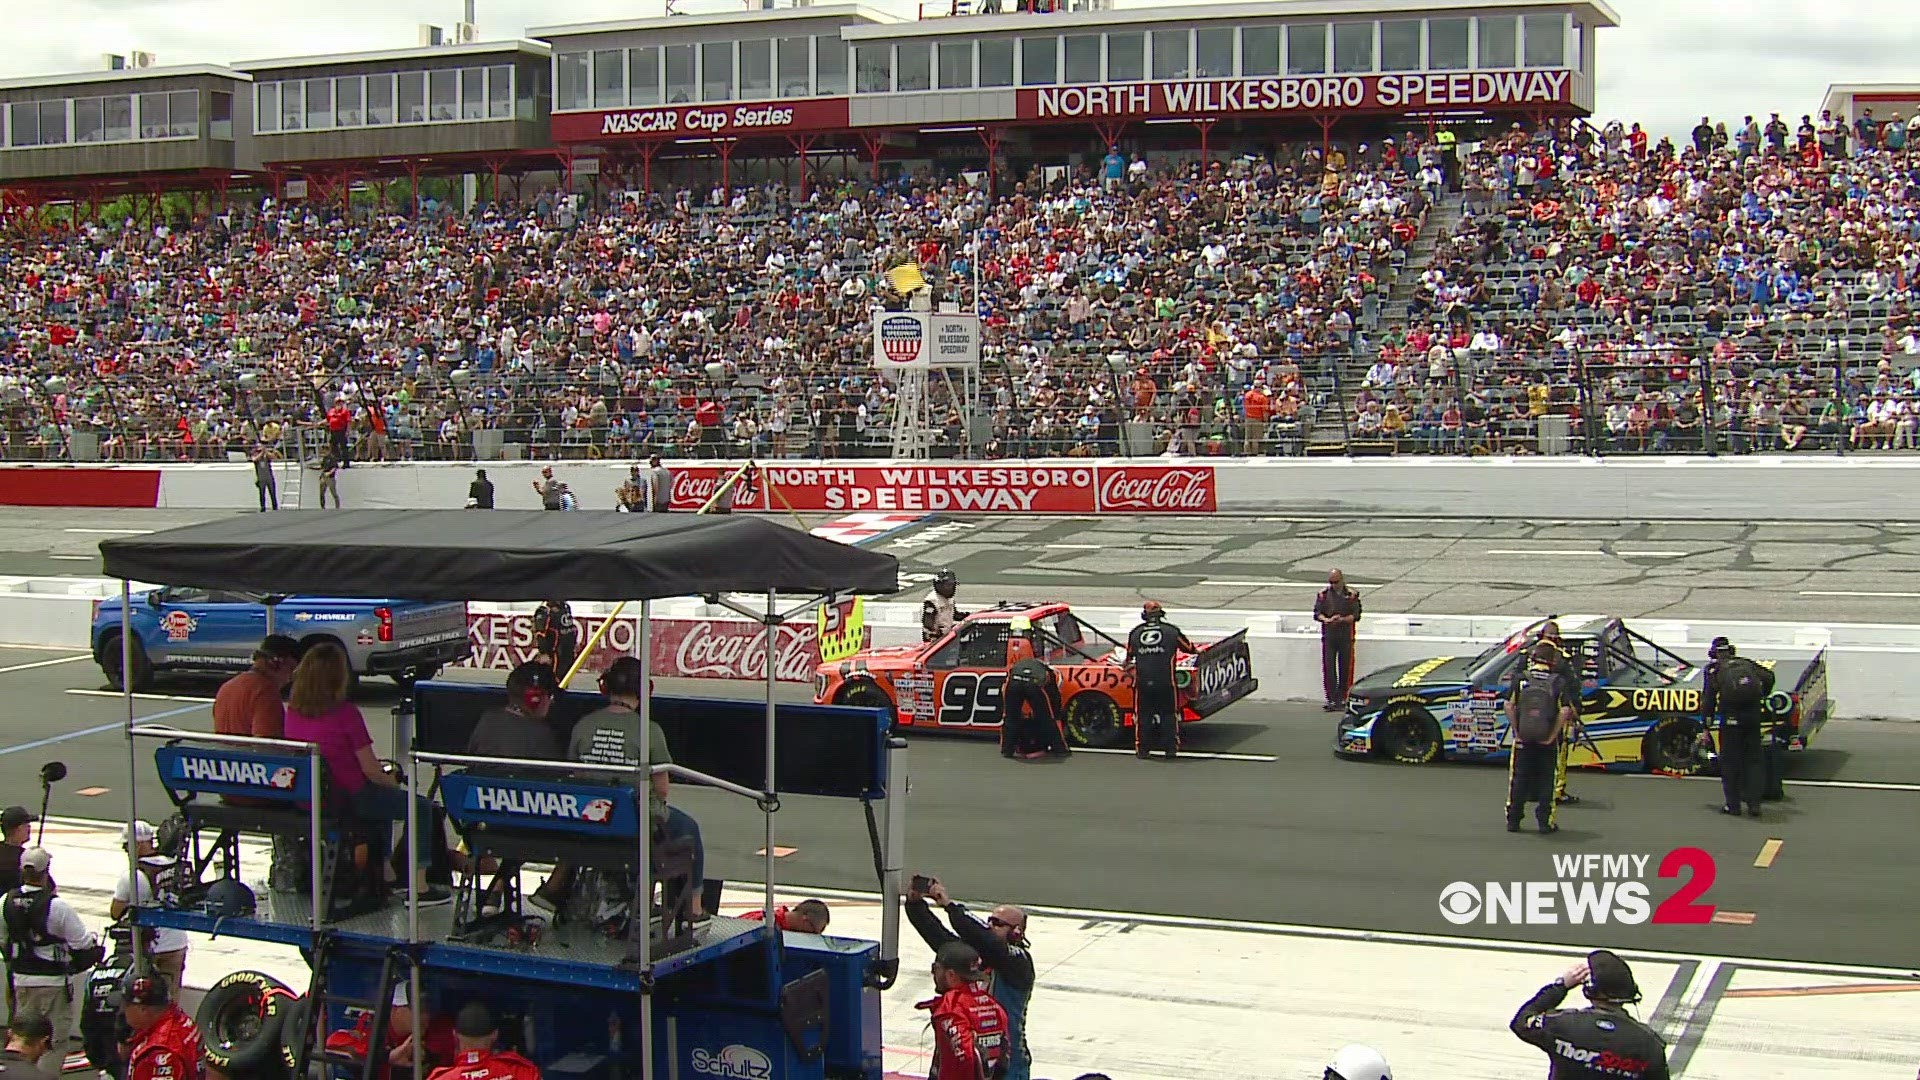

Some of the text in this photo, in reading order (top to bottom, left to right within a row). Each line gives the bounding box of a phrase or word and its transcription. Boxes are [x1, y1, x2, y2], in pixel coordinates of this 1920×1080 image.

[1038, 71, 1570, 117] NORTH WILKESBORO SPEEDWAY
[601, 105, 793, 134] NASCAR Cup Series
[768, 469, 1091, 487] NORTH WILKESBORO
[1100, 470, 1211, 508] Coca-Cola
[825, 487, 1038, 510] SPEEDWAY
[314, 613, 357, 621] CHEVROLET
[169, 629, 188, 638] 250
[1200, 653, 1247, 696] Kubota
[938, 671, 1008, 727] 99
[1632, 688, 1700, 711] GAINB
[182, 756, 270, 785] HALMAR
[477, 786, 580, 818] HALMAR
[221, 972, 277, 1016] GOODYEAR
[692, 1048, 770, 1080] Schultz
